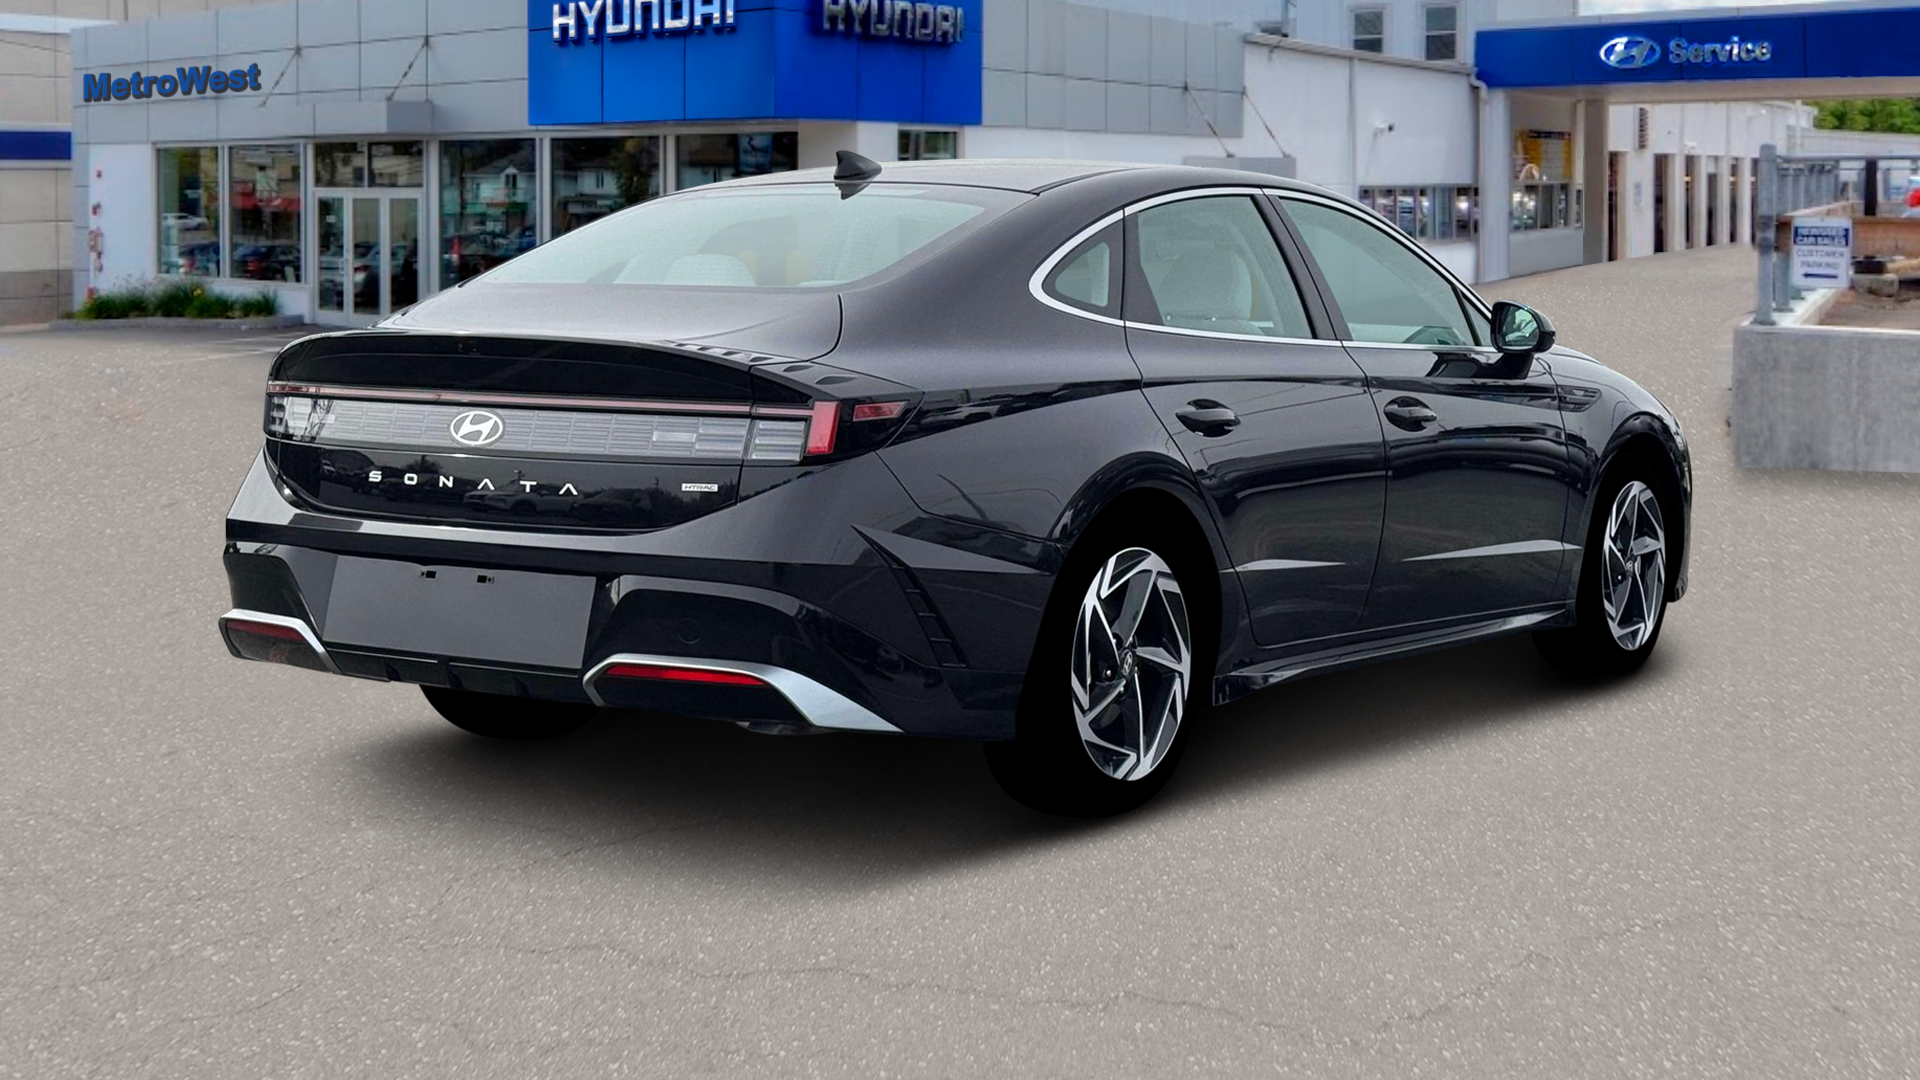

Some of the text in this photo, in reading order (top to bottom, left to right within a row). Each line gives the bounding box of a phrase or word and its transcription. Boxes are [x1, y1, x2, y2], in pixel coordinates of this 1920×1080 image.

[553, 0, 735, 39] HYUNDAI
[823, 0, 964, 43] HYUNDAI
[1669, 36, 1771, 63] Service
[83, 63, 261, 102] MetroWest
[1796, 249, 1844, 258] CUSTOMER
[1817, 236, 1846, 247] SALES
[1801, 260, 1839, 269] PARKING
[368, 470, 578, 495] SONATA
